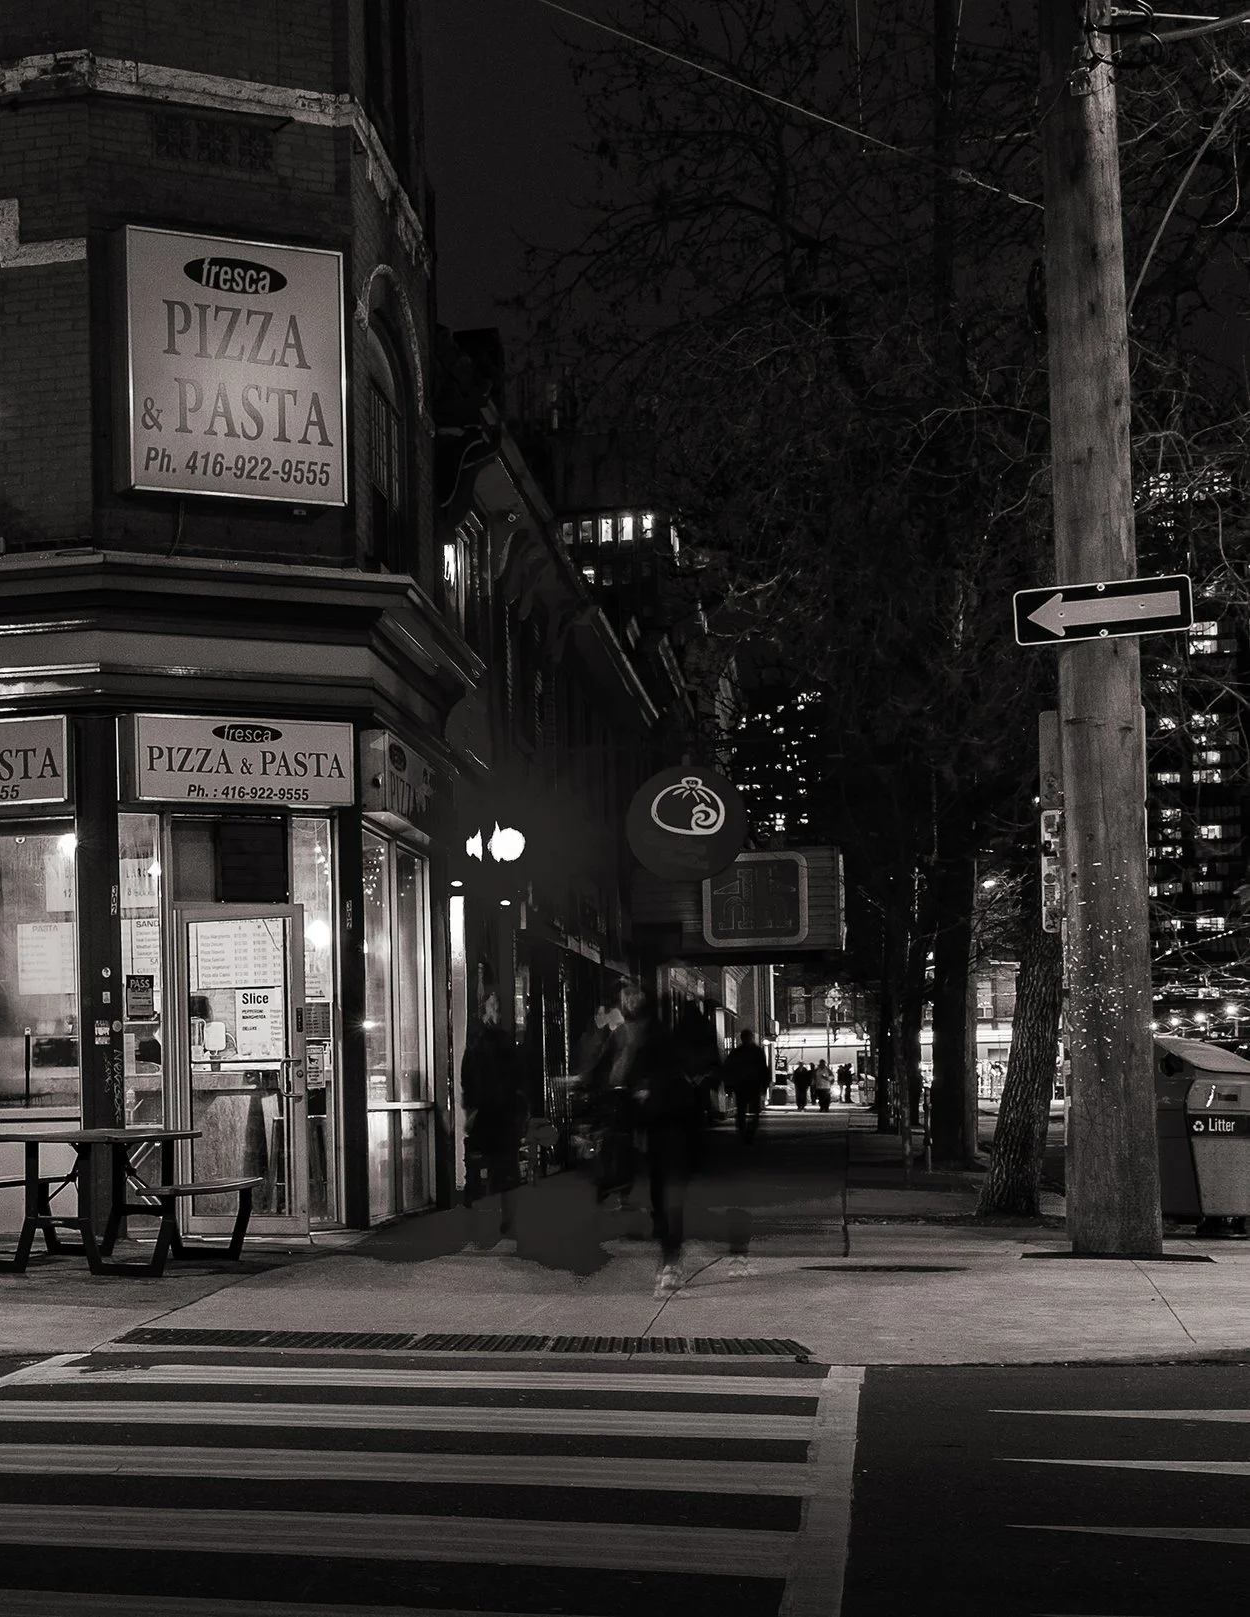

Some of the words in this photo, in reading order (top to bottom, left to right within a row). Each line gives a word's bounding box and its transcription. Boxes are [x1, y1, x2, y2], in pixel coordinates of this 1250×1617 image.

[201, 258, 271, 294] fresca
[162, 299, 312, 370] PIZZA
[141, 397, 163, 432] &
[174, 377, 334, 447] PASTA
[144, 447, 177, 474] Ph.
[186, 451, 331, 487] 416-922-9555
[224, 725, 273, 743] fresca
[147, 746, 234, 775] PIZZA
[240, 758, 254, 775] &
[260, 750, 346, 779] PASTA
[221, 786, 310, 801] 416-922-9555
[130, 979, 151, 988] PASS
[242, 993, 269, 1004] Slice
[1208, 1117, 1235, 1132] Litter
